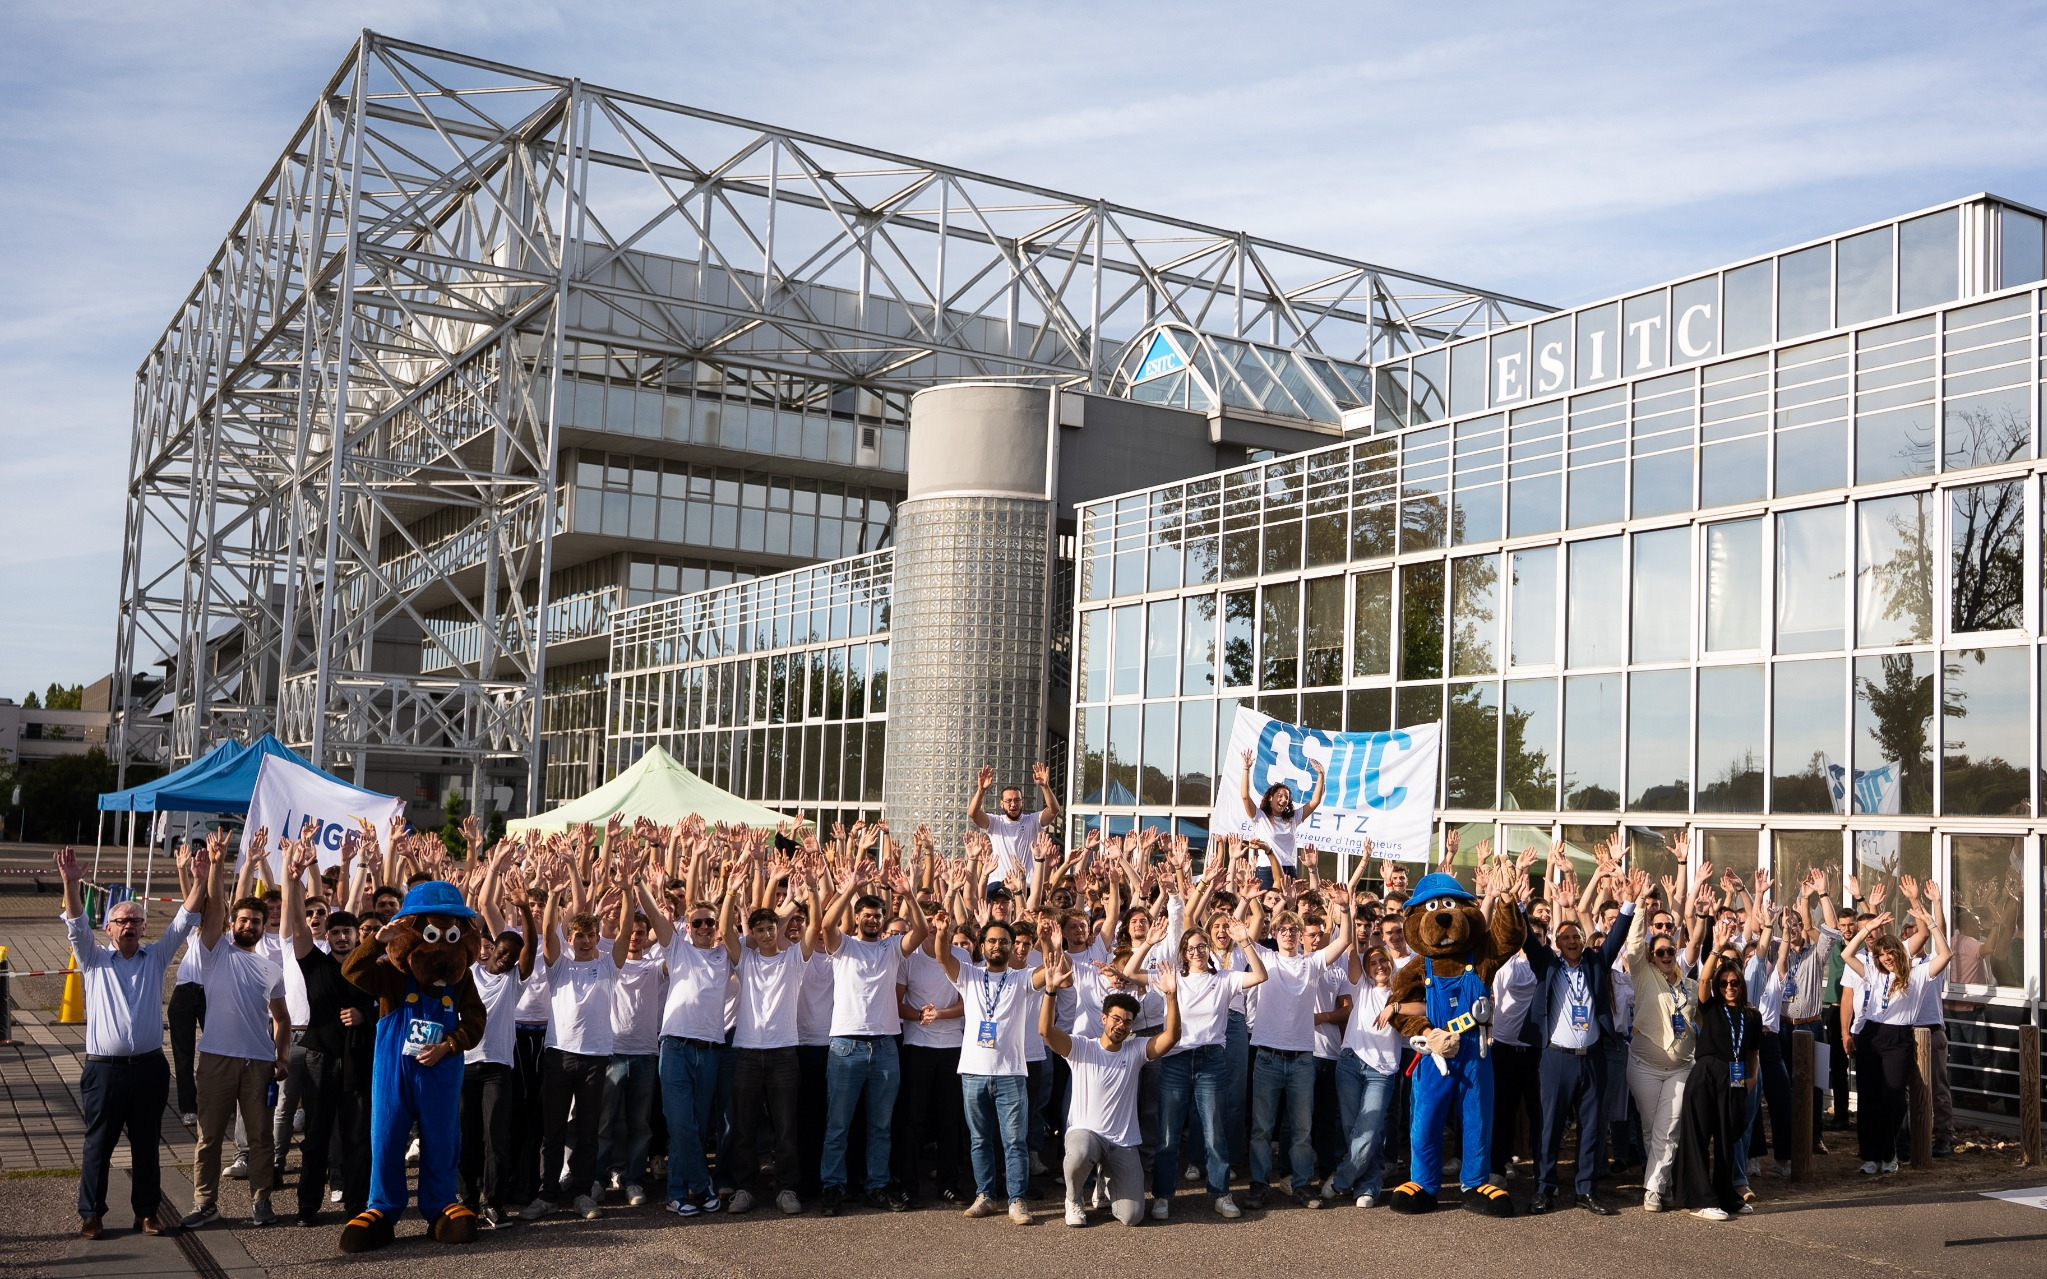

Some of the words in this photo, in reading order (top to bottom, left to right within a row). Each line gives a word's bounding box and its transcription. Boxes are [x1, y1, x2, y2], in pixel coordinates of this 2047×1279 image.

[1145, 353, 1175, 377] ESITC
[1496, 304, 1713, 403] ESITC
[1253, 720, 1413, 811] ESITC
[1309, 812, 1370, 834] ETZ
[1330, 845, 1401, 859] Constrction
[1335, 837, 1402, 850] d'Ingnieurs
